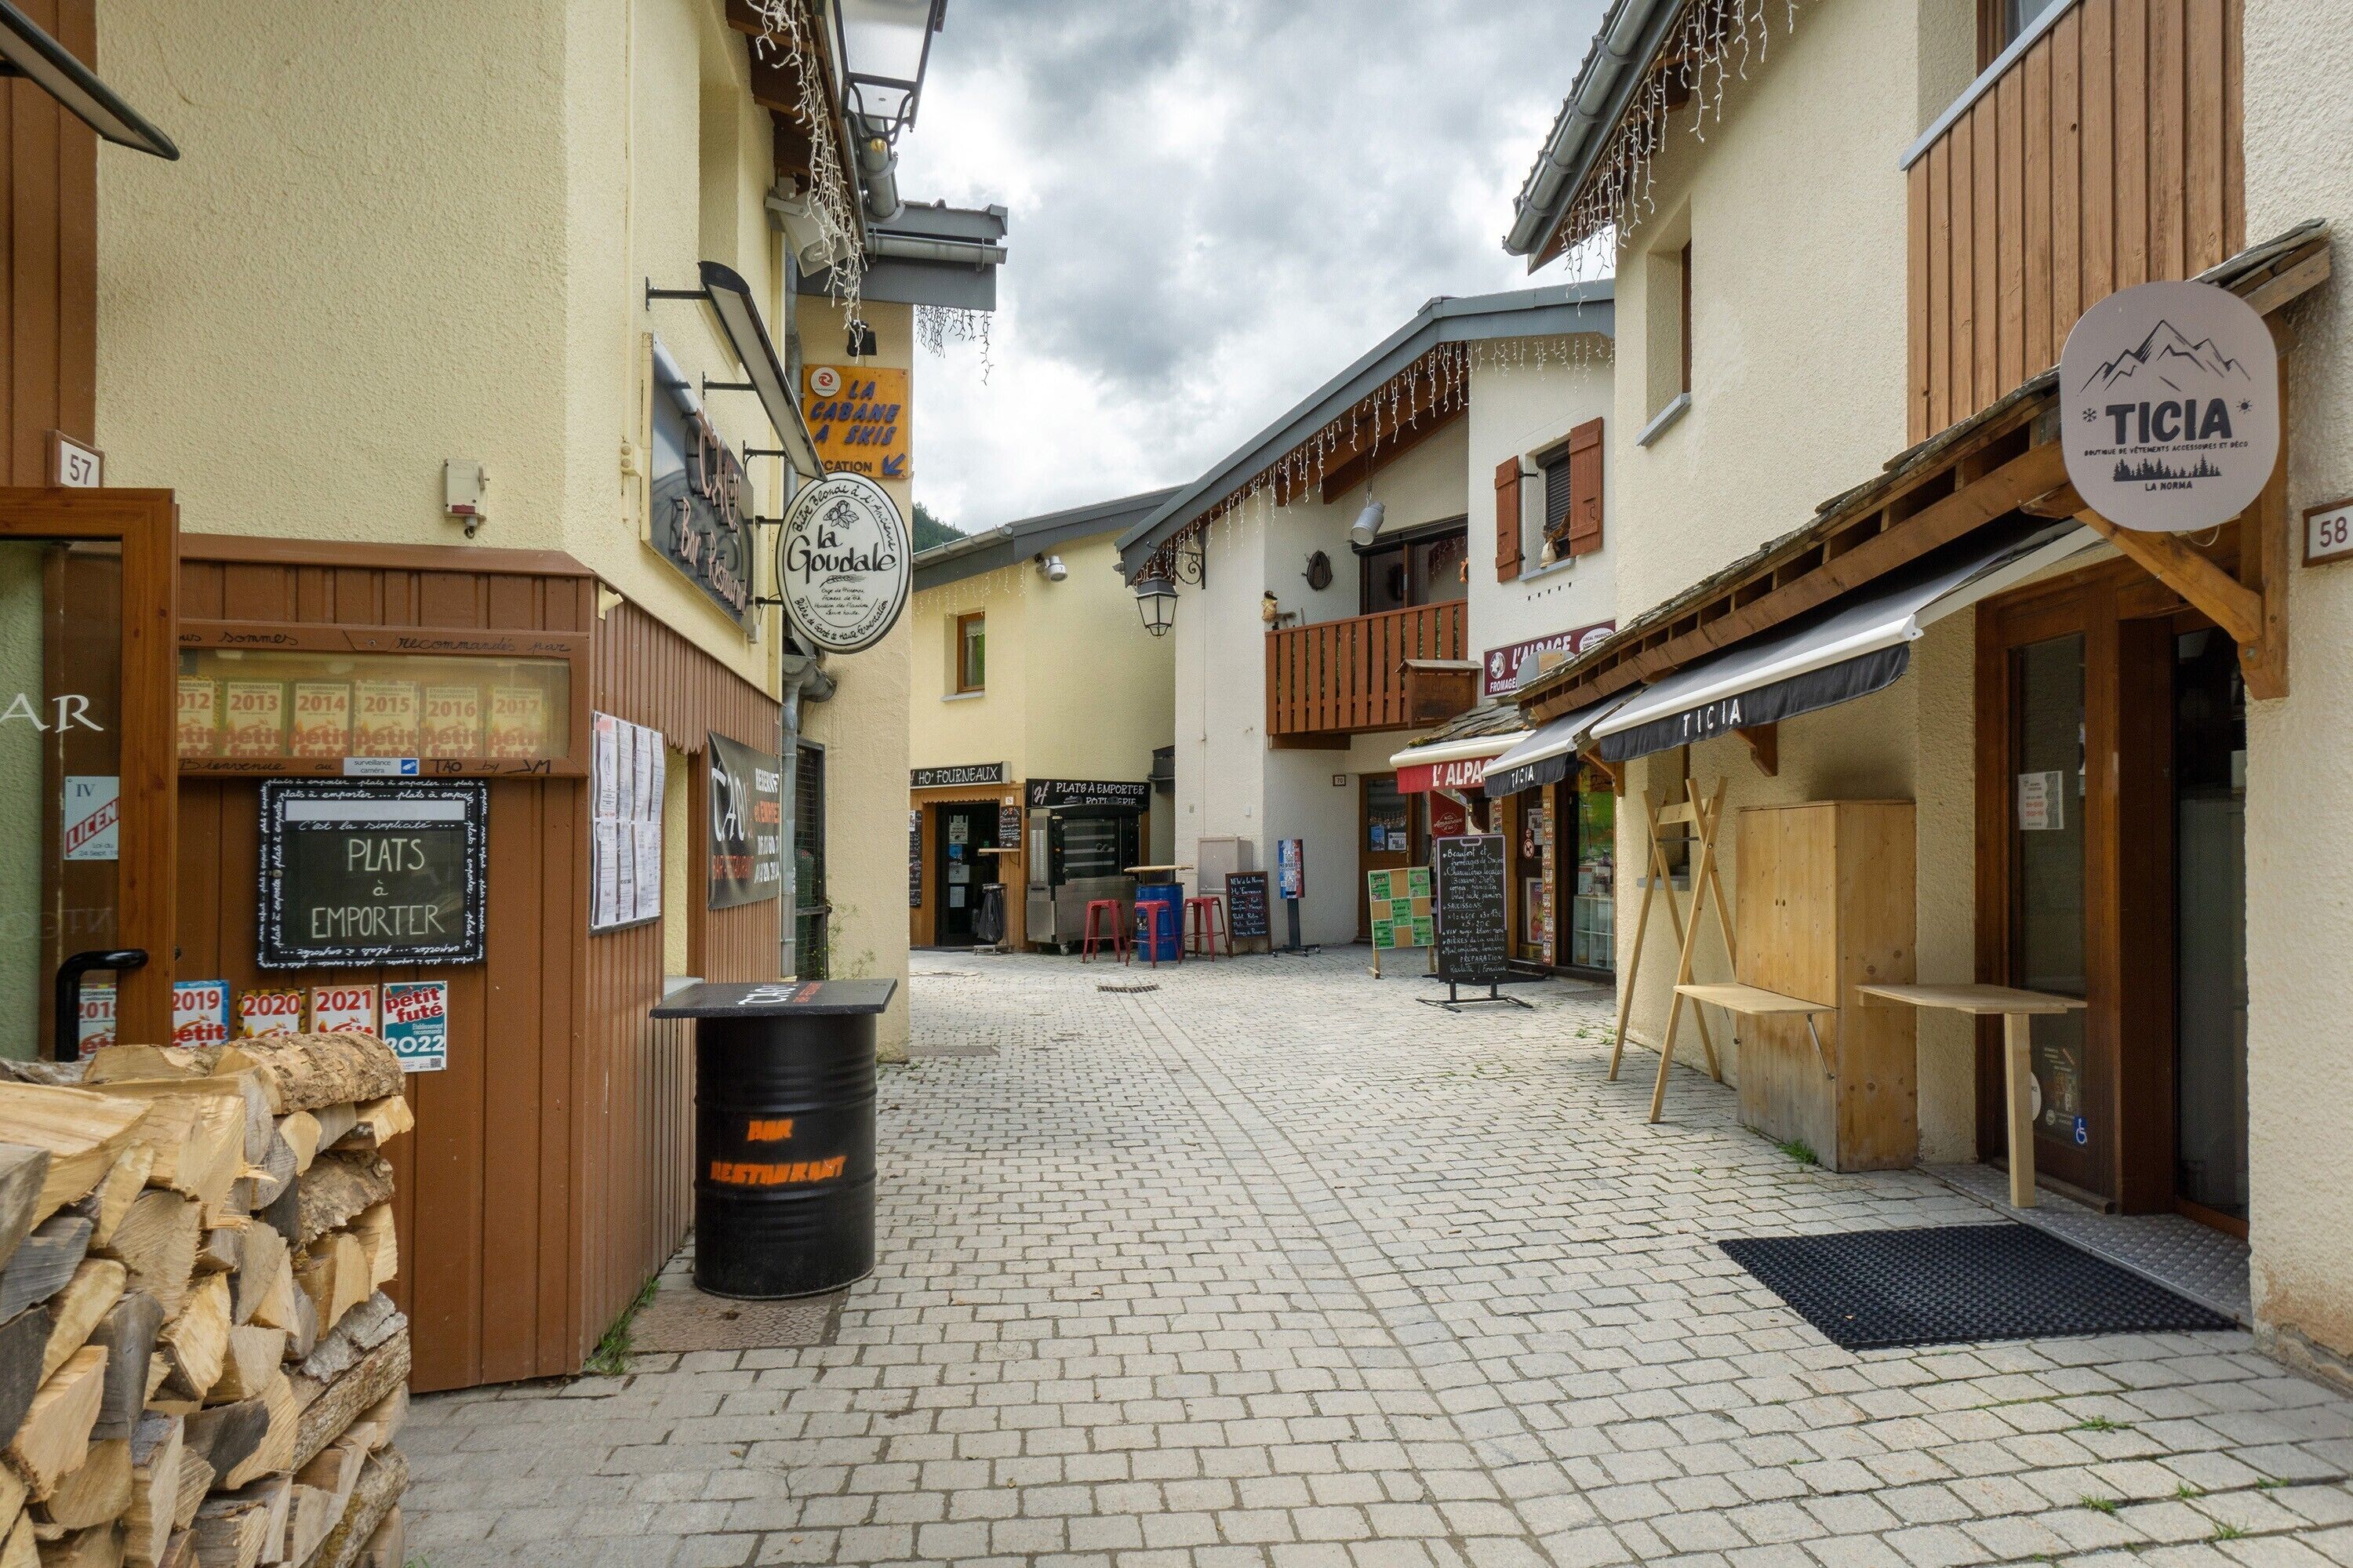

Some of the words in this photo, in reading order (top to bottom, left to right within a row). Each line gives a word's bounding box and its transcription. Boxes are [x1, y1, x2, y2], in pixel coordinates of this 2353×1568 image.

[849, 380, 875, 398] LA
[810, 401, 901, 422] CABANE
[2106, 398, 2232, 445] TICIA
[814, 424, 829, 442] A
[844, 425, 897, 445] SKIS
[2130, 445, 2169, 453] VÊTEMENTS
[2173, 442, 2217, 451] ACCESSOIRES
[70, 453, 92, 485] 57
[821, 460, 872, 472] CATION
[2145, 482, 2156, 492] LA
[2160, 480, 2192, 490] NORMA
[792, 505, 813, 533] Bière
[809, 483, 849, 507] Blonde
[817, 524, 843, 548] la
[2320, 516, 2348, 548] 58
[787, 535, 896, 584] Goudale
[795, 597, 808, 619] Bière
[219, 631, 298, 645] sommes
[397, 637, 515, 651] recommandés
[528, 642, 571, 655] par
[178, 693, 210, 710] 012
[231, 694, 277, 711] 2013
[298, 696, 345, 711] 2014
[363, 697, 410, 713] 2015
[427, 701, 476, 718] 2016
[495, 698, 540, 715] 2017
[1683, 699, 1742, 737] TICIA
[178, 728, 215, 744] etit
[429, 759, 463, 773] TAO
[936, 766, 998, 783] FOURNEAUX
[1511, 765, 1534, 788] TICIA
[76, 784, 95, 797] IV
[278, 789, 304, 801] plats
[322, 790, 375, 799] emporter
[395, 790, 424, 800] plats
[1056, 783, 1086, 793] PLATS
[1088, 781, 1095, 793] À
[1097, 784, 1144, 795] EMPORTER
[299, 820, 332, 831] C'est
[339, 820, 357, 830] la
[364, 820, 432, 830] simplicité
[347, 838, 424, 871] PLATS
[373, 879, 388, 896] à
[311, 905, 445, 938] EMPORTER
[173, 990, 220, 1012] 2019
[242, 994, 301, 1017] 2020
[315, 989, 371, 1012] 2021
[384, 987, 440, 1013] petit
[396, 1002, 444, 1024] futé
[384, 1035, 444, 1053] 2022
